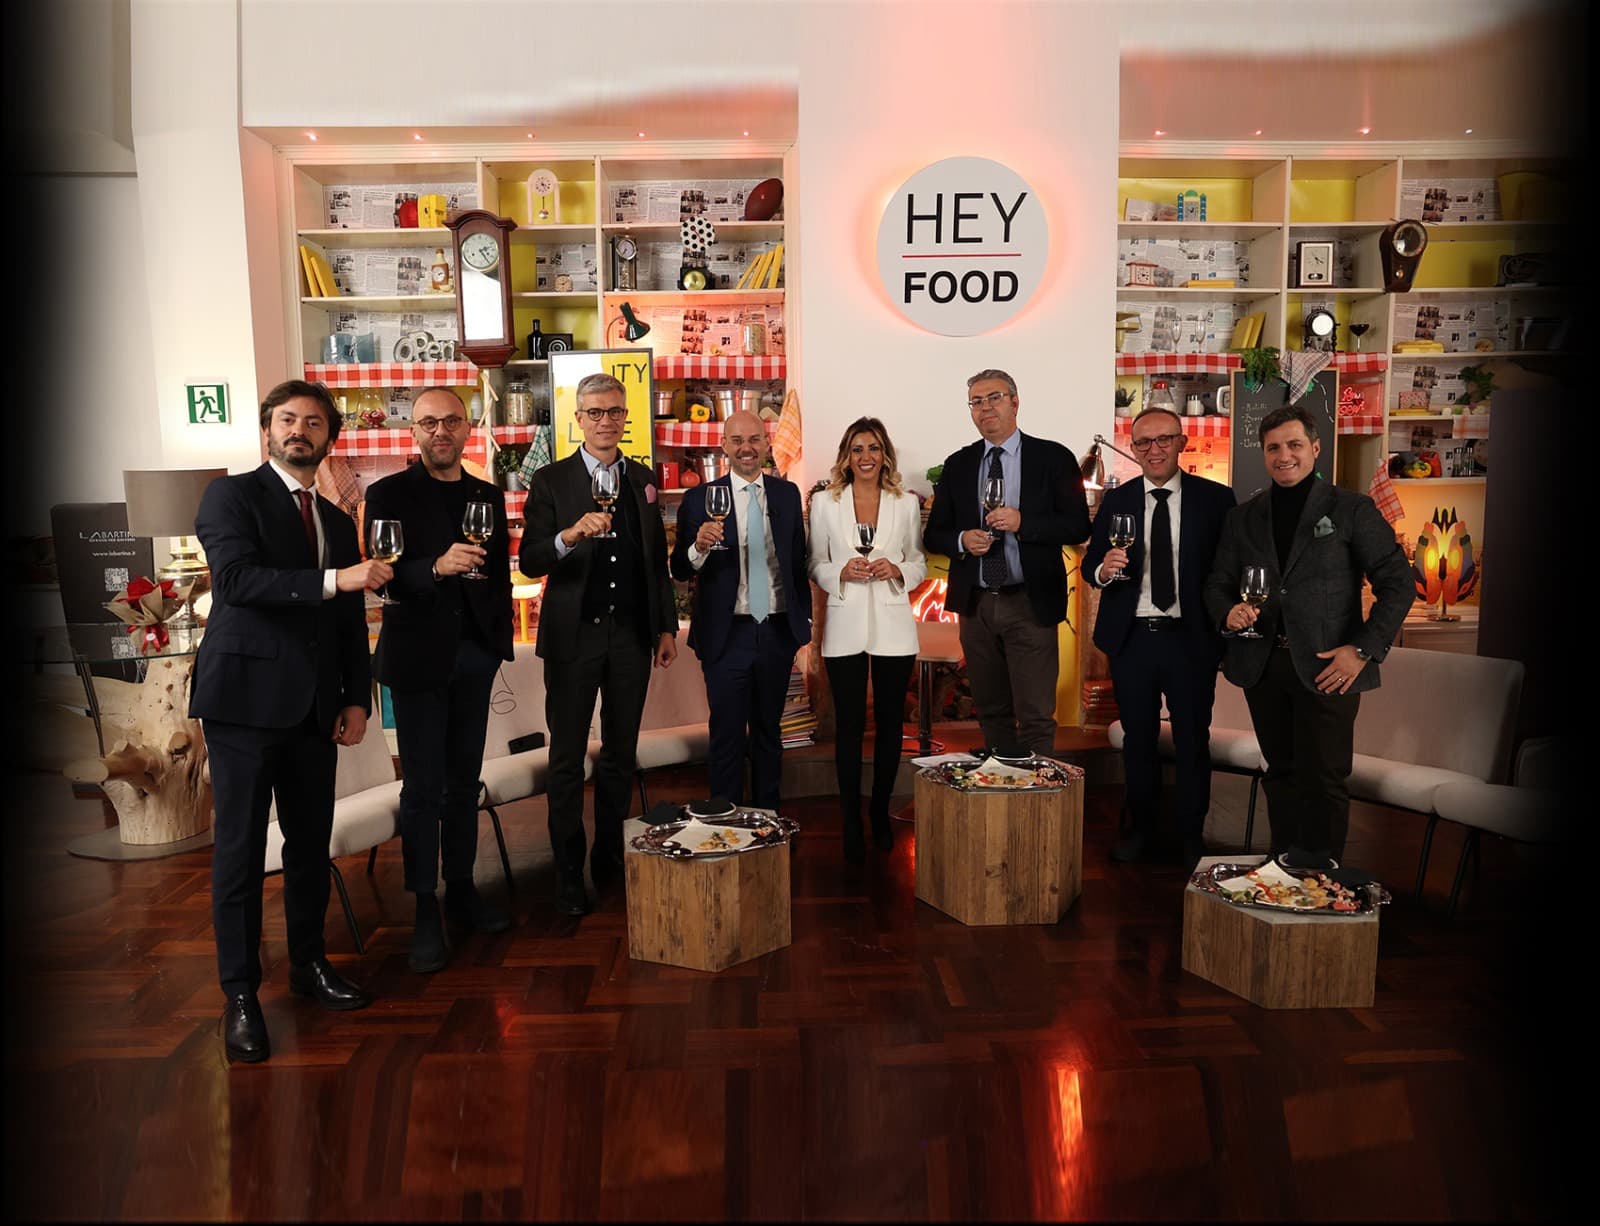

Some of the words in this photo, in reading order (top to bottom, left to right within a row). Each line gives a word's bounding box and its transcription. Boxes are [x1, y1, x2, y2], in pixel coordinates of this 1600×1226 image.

[906, 192, 1028, 244] HEY
[904, 270, 1019, 303] FOOD
[611, 362, 648, 383] ITY
